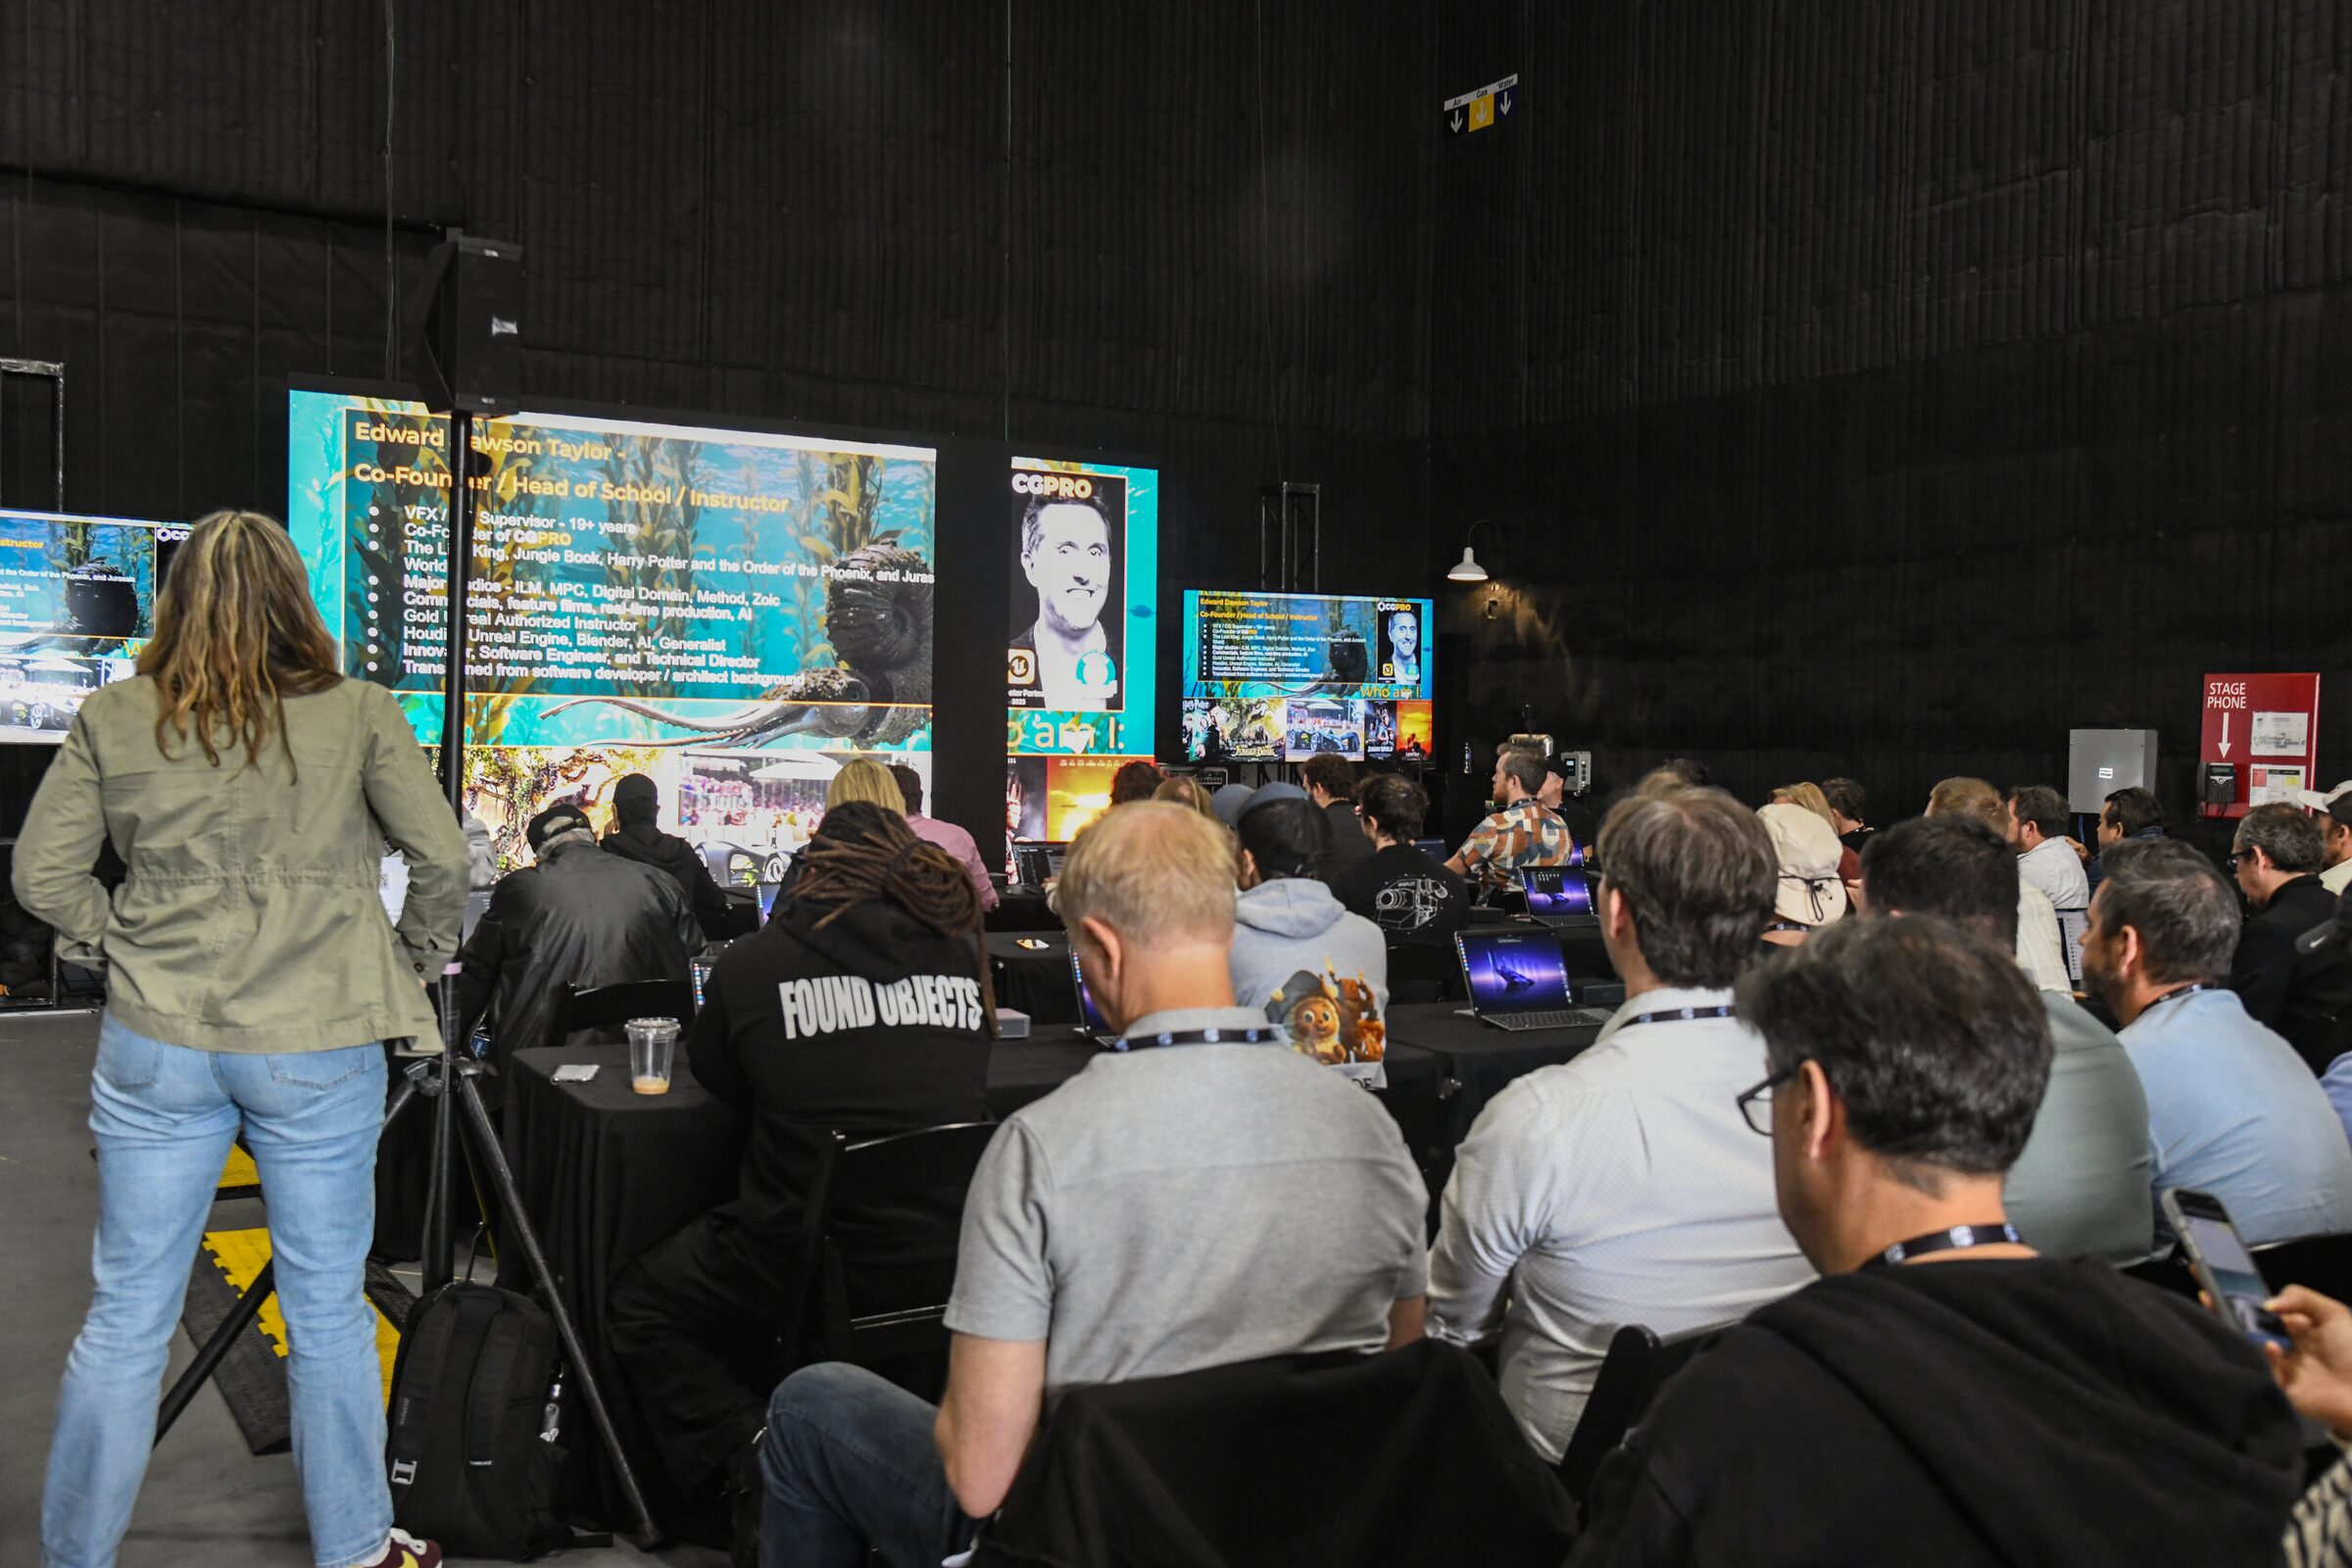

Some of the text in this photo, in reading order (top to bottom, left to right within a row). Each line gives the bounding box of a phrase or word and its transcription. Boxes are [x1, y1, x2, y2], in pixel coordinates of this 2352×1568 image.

[1476, 89, 1488, 98] Gas
[1497, 78, 1514, 90] Water
[355, 421, 444, 447] Edward
[470, 435, 540, 455] awson
[546, 439, 612, 463] Taylor
[354, 463, 492, 490] Co-Founer
[513, 476, 568, 498] Head
[574, 481, 597, 499] of
[600, 483, 671, 505] School
[690, 490, 789, 512] Instructor
[1012, 473, 1093, 498] CGPRO
[404, 506, 439, 521] VFX
[479, 511, 556, 529] Supervisor
[569, 517, 595, 531] 19+
[598, 522, 641, 535] years
[494, 529, 511, 542] of
[404, 540, 434, 555] The
[473, 544, 509, 561] King,
[514, 547, 560, 564] Jungle
[564, 550, 604, 566] Book,
[608, 552, 644, 569] Harry
[647, 555, 688, 570] Potter
[691, 559, 716, 571] and
[719, 560, 740, 572] the
[742, 560, 782, 574] Order
[783, 563, 797, 576] of
[798, 564, 818, 577] the
[821, 564, 874, 582] Phoenix,
[876, 569, 899, 582] and
[404, 557, 447, 572] World
[403, 574, 447, 592] Major
[515, 581, 546, 596] ILM,
[550, 583, 588, 598] MPC,
[592, 585, 635, 601] Digital
[638, 587, 693, 604] Domain,
[697, 590, 749, 606] Method,
[507, 596, 557, 612] feature
[560, 599, 596, 615] films,
[662, 606, 735, 621] production,
[737, 608, 753, 621] AI
[1385, 603, 1412, 612] CGPRO
[403, 608, 439, 623] Gold
[494, 612, 570, 628] Authorized
[574, 616, 638, 632] Instructor
[468, 629, 516, 643] Unreal
[520, 631, 573, 647] Engine,
[577, 634, 634, 650] Blender,
[637, 636, 656, 650] AI,
[659, 637, 727, 652] Generalist
[479, 645, 543, 661] Software
[546, 648, 611, 664] Engineer,
[614, 651, 641, 664] and
[644, 652, 706, 667] Technical
[709, 654, 761, 668] Director
[496, 666, 529, 677] from
[532, 667, 591, 679] software
[594, 667, 662, 683] developer
[1360, 685, 1390, 697] Who
[2209, 683, 2246, 695] STAGE
[2207, 696, 2247, 709] PHONE
[1034, 720, 1096, 749] am
[1108, 716, 1125, 749] I:
[779, 976, 876, 1040] FOUND
